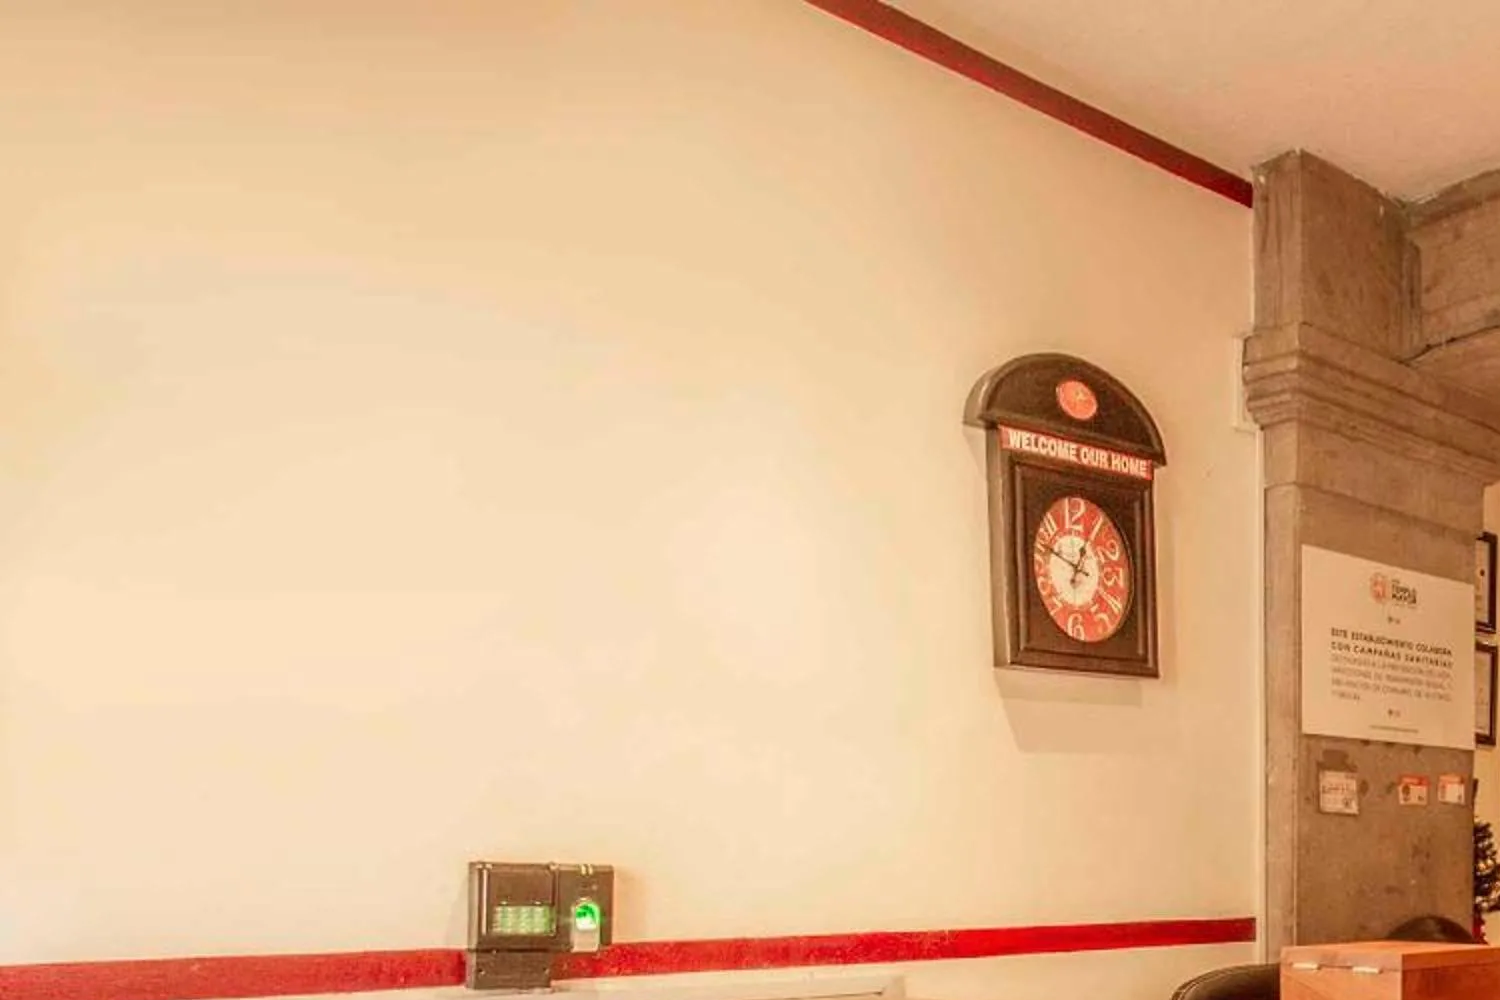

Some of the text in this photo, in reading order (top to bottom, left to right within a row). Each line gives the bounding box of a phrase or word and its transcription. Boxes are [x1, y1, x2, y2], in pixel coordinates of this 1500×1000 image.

[1008, 430, 1147, 477] WELCOME OUR HOME
[1064, 497, 1086, 531] 12
[1097, 538, 1120, 563] 2
[1103, 567, 1125, 589] 3
[1067, 613, 1085, 641] 6
[1331, 641, 1350, 652] CON
